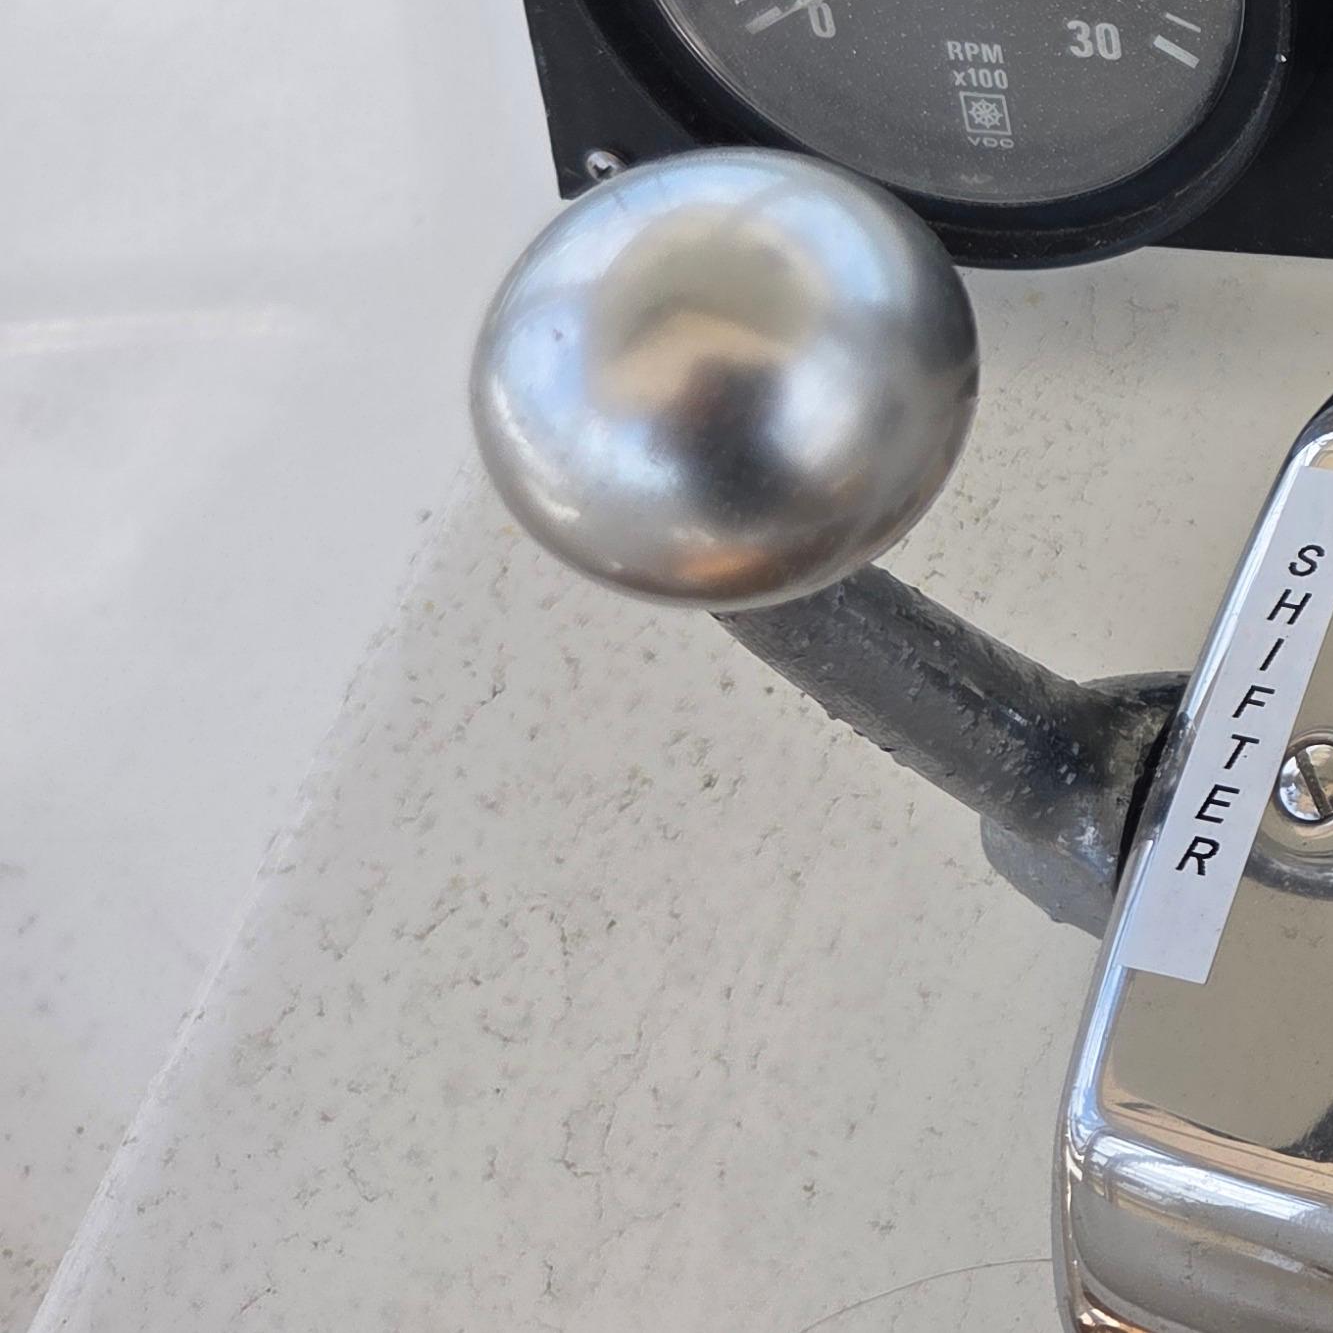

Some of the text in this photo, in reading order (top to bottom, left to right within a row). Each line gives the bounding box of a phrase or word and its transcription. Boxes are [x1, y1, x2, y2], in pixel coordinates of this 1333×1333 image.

[808, 2, 837, 38] 0
[946, 40, 1005, 65] RPM
[1066, 19, 1122, 62] 30
[953, 67, 1009, 91] x100
[967, 136, 1014, 148] VDO
[1176, 542, 1326, 878] SHIFTER
